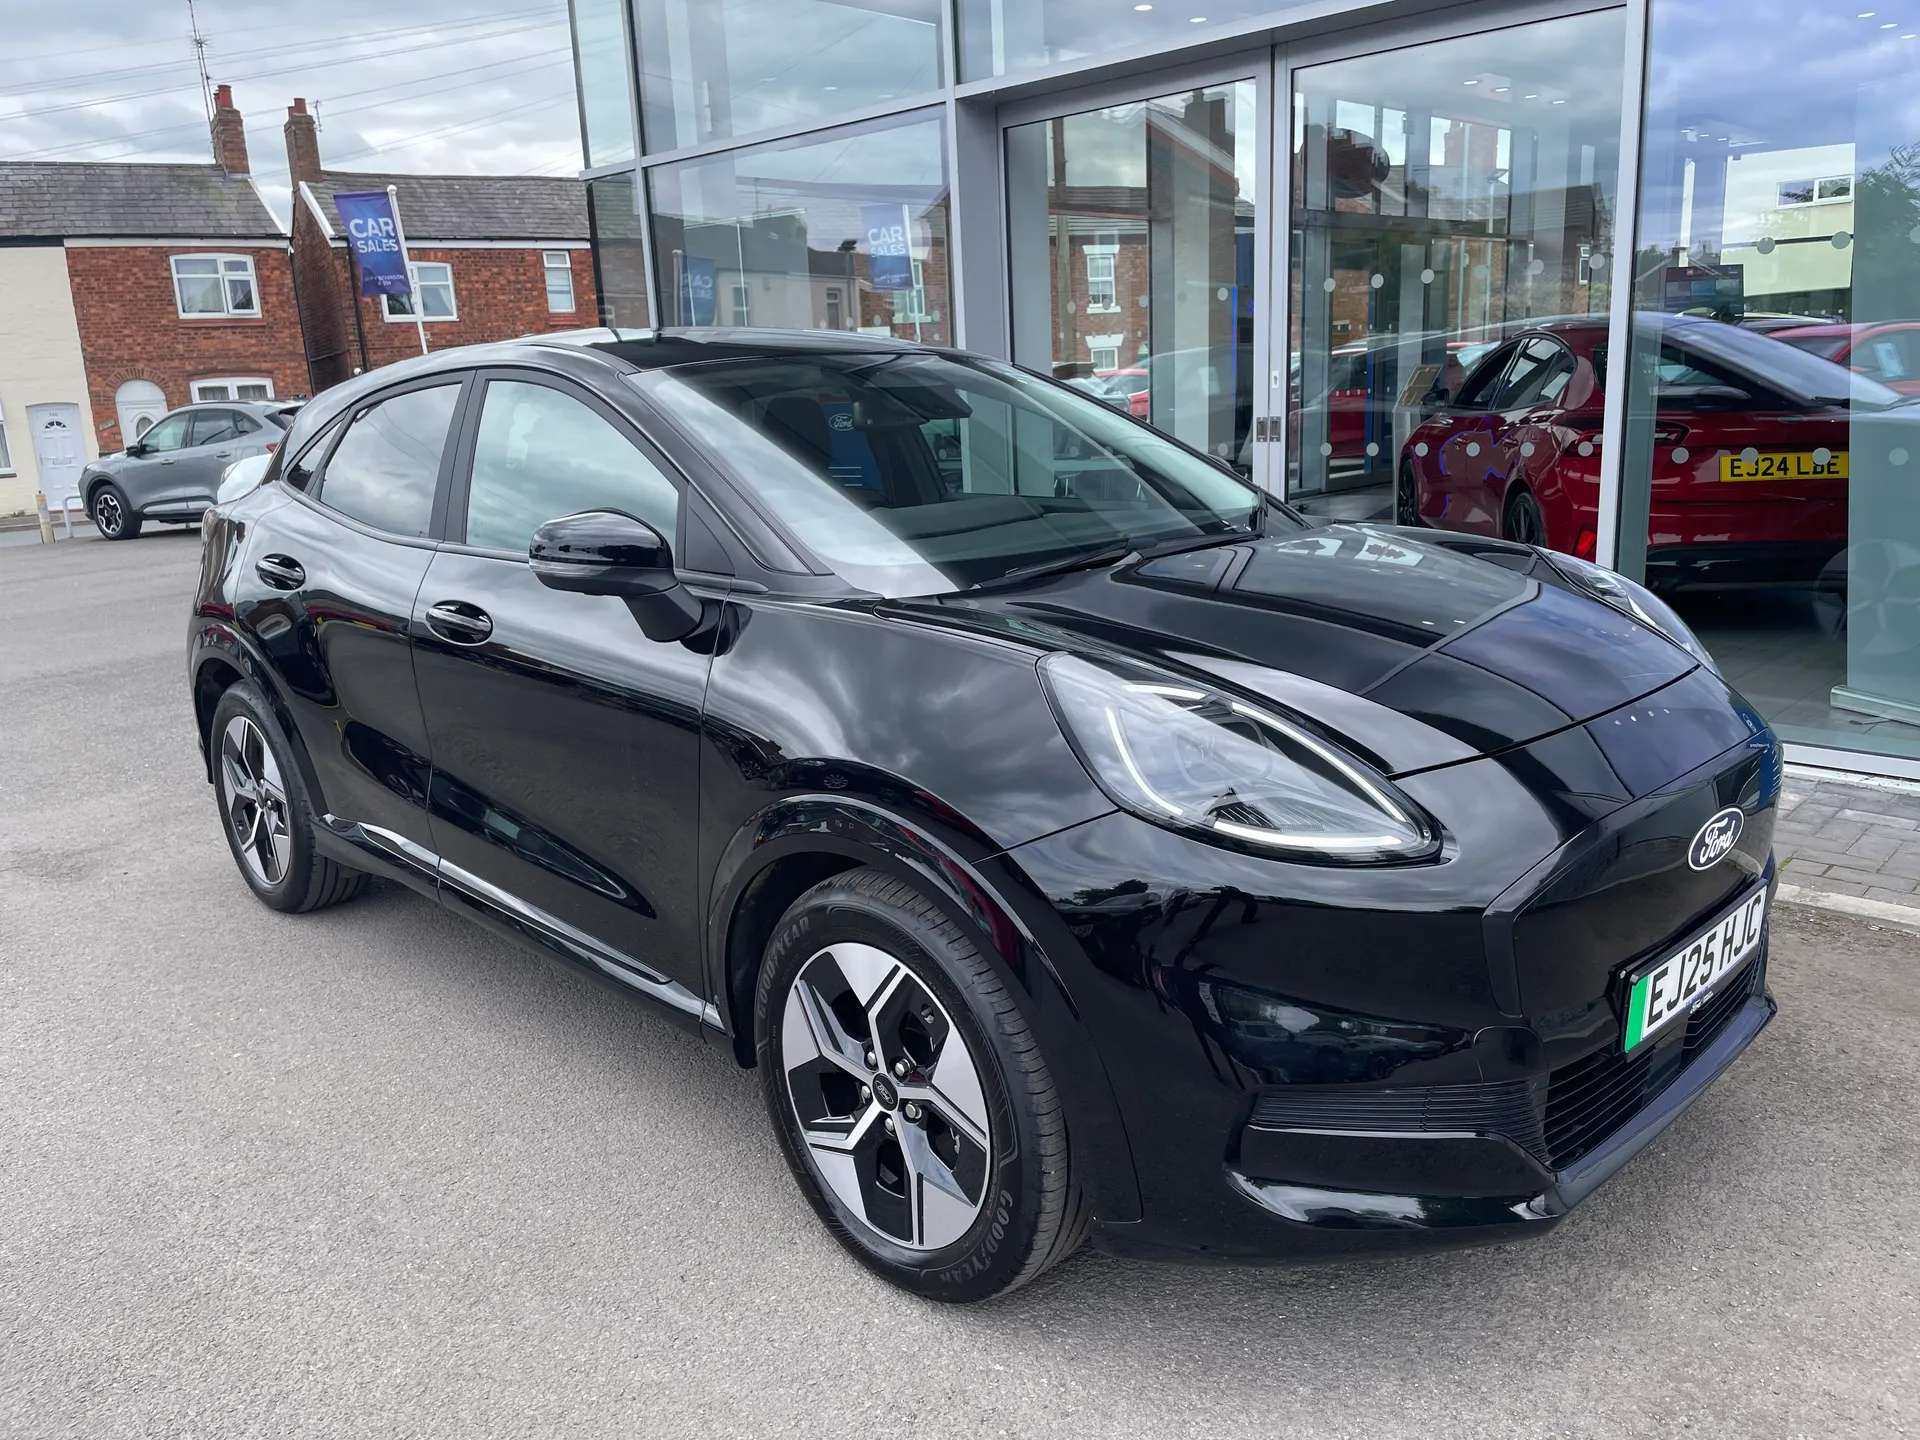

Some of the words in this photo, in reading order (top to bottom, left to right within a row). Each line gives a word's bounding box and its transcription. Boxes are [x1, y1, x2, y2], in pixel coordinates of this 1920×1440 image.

[349, 217, 395, 239] CAR
[868, 226, 904, 244] CAR
[357, 239, 398, 253] SALES
[871, 244, 905, 258] SALES
[1730, 456, 1789, 478] EJ24
[1698, 815, 1737, 866] Ford
[1647, 930, 1717, 1028] EJ25
[1719, 894, 1761, 972] HJC
